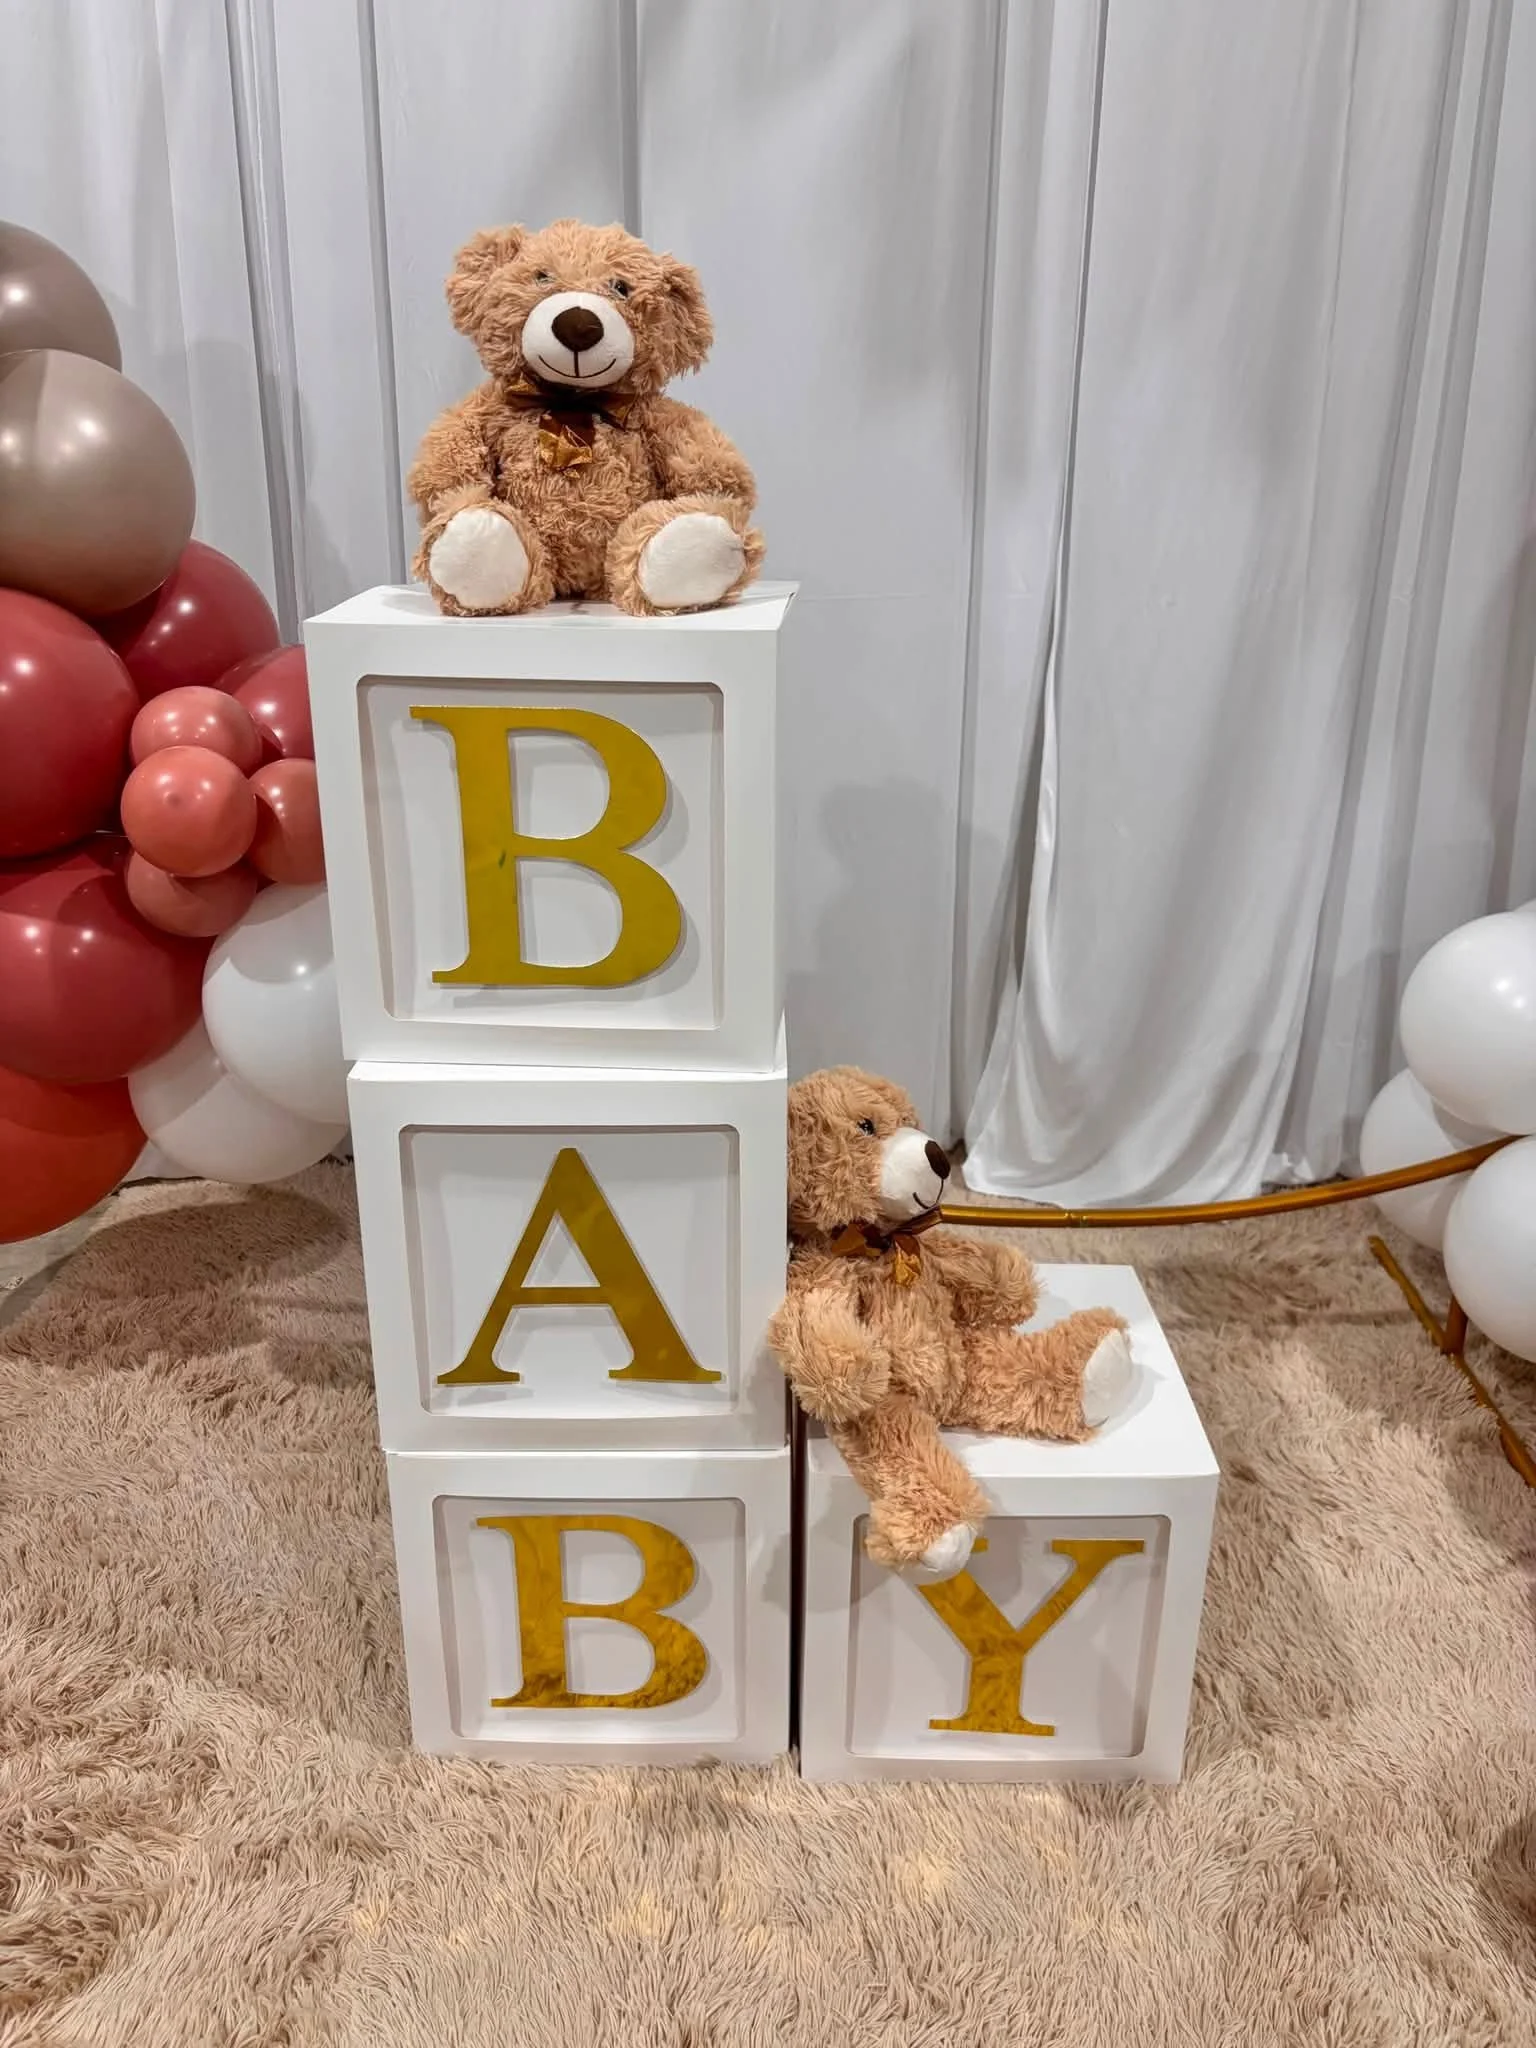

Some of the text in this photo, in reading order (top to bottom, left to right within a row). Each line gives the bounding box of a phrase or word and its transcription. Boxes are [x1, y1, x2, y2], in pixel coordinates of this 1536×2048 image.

[409, 705, 682, 989] B
[437, 1147, 722, 1385] A
[476, 1514, 709, 1709] B
[917, 1538, 1145, 1737] Y
